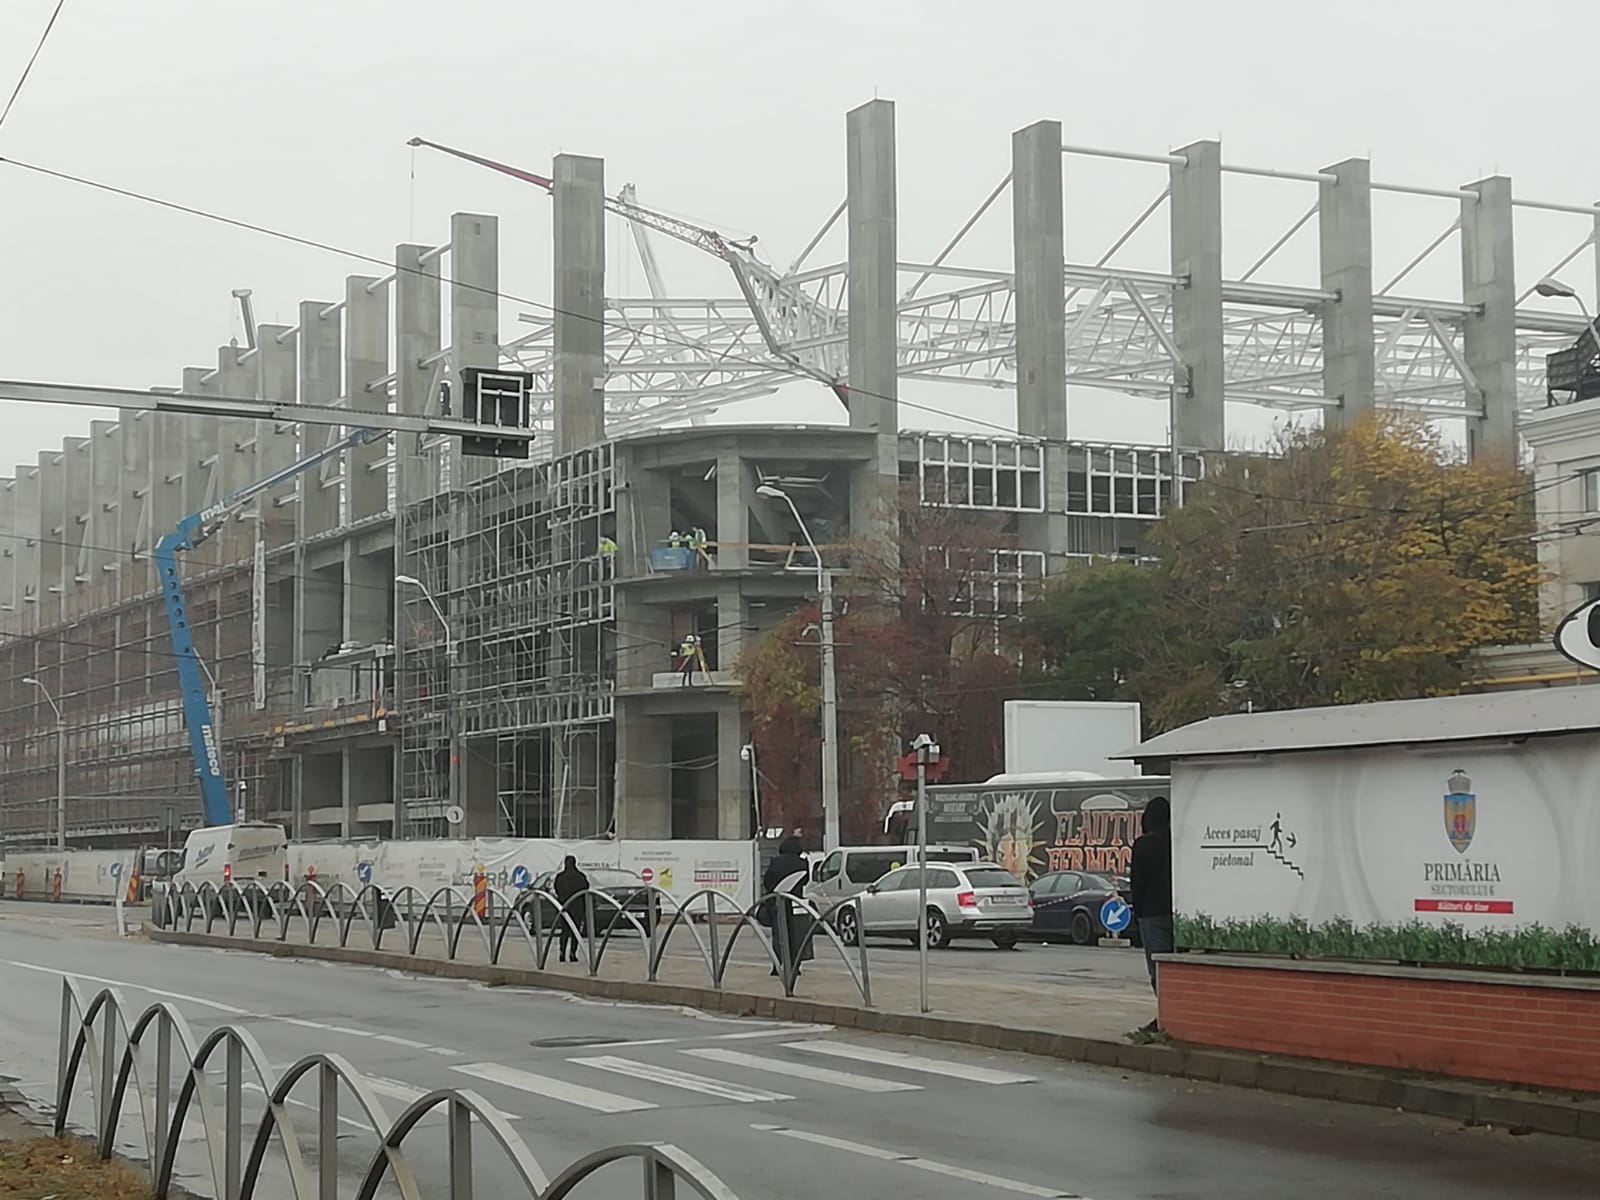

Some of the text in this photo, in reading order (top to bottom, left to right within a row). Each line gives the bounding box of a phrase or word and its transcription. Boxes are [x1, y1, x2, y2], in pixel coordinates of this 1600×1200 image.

[201, 725, 220, 776] mateco
[1204, 825, 1261, 842] Acces pasaj
[1212, 852, 1254, 870] pietonal
[1424, 859, 1501, 882] PRIMĂRIA
[1431, 884, 1495, 896] SECTORULUI 6
